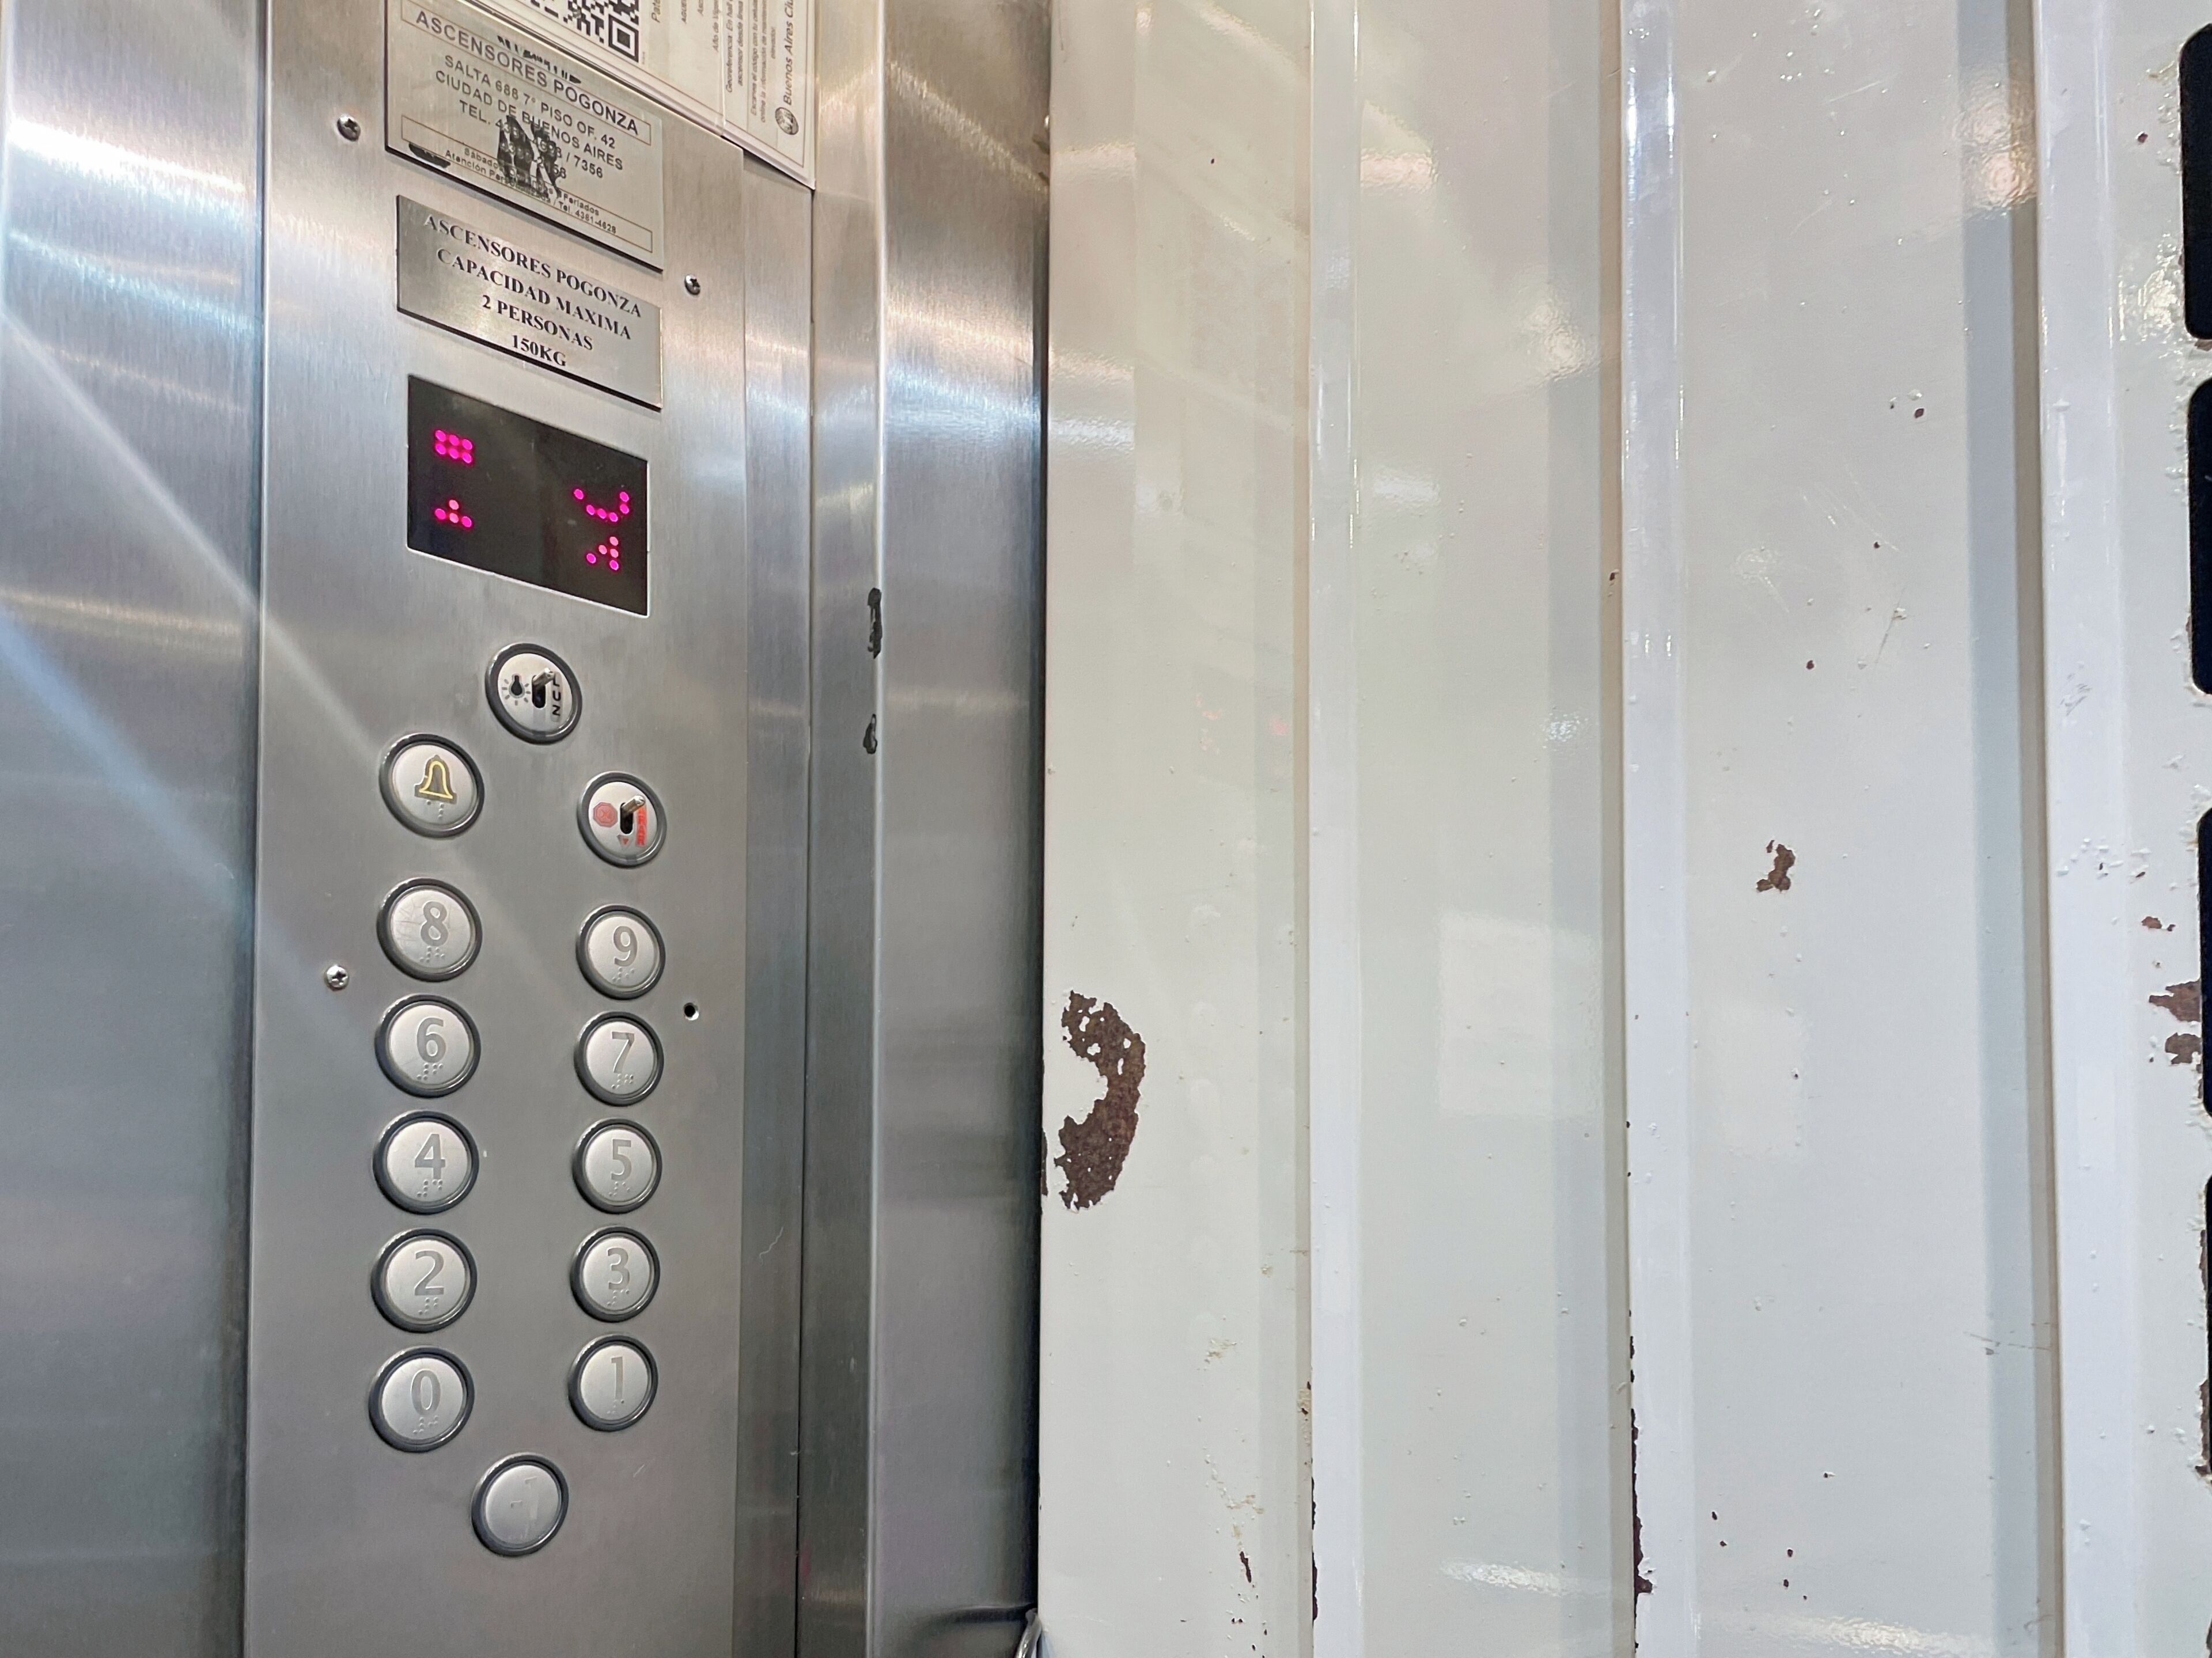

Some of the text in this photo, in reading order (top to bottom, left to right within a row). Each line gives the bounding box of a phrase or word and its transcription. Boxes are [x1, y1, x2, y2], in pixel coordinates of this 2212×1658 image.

[712, 24, 719, 33] de
[726, 18, 733, 32] En
[783, 21, 794, 56] Aires
[416, 10, 639, 135] ASCENSORES POGONZA
[783, 56, 793, 106] Buenos
[435, 70, 623, 170] CIUDAD DE BUENOS AIRES
[445, 55, 491, 88] SALTA
[495, 80, 518, 101] 688
[541, 102, 573, 127] PISO
[577, 121, 597, 141] OF.
[601, 134, 616, 149] 42
[445, 150, 486, 174] Atención
[459, 100, 491, 126] TEL.
[574, 155, 603, 179] 7356
[563, 193, 599, 216] Feriados
[424, 214, 641, 318] ASCENSORES POGONZA
[437, 248, 631, 340] CAPACIDAD MAXIMA
[482, 294, 593, 351] 2 PERSONAS
[512, 335, 567, 367] 150KG
[420, 900, 449, 947] 8
[613, 925, 638, 967] 9
[416, 1016, 447, 1063] 6
[611, 1031, 635, 1073] 7
[414, 1133, 446, 1181] 4
[610, 1139, 632, 1182] 5
[414, 1250, 445, 1296] 2
[606, 1247, 631, 1291] 3
[410, 1368, 441, 1416] 0
[610, 1356, 626, 1400] 1
